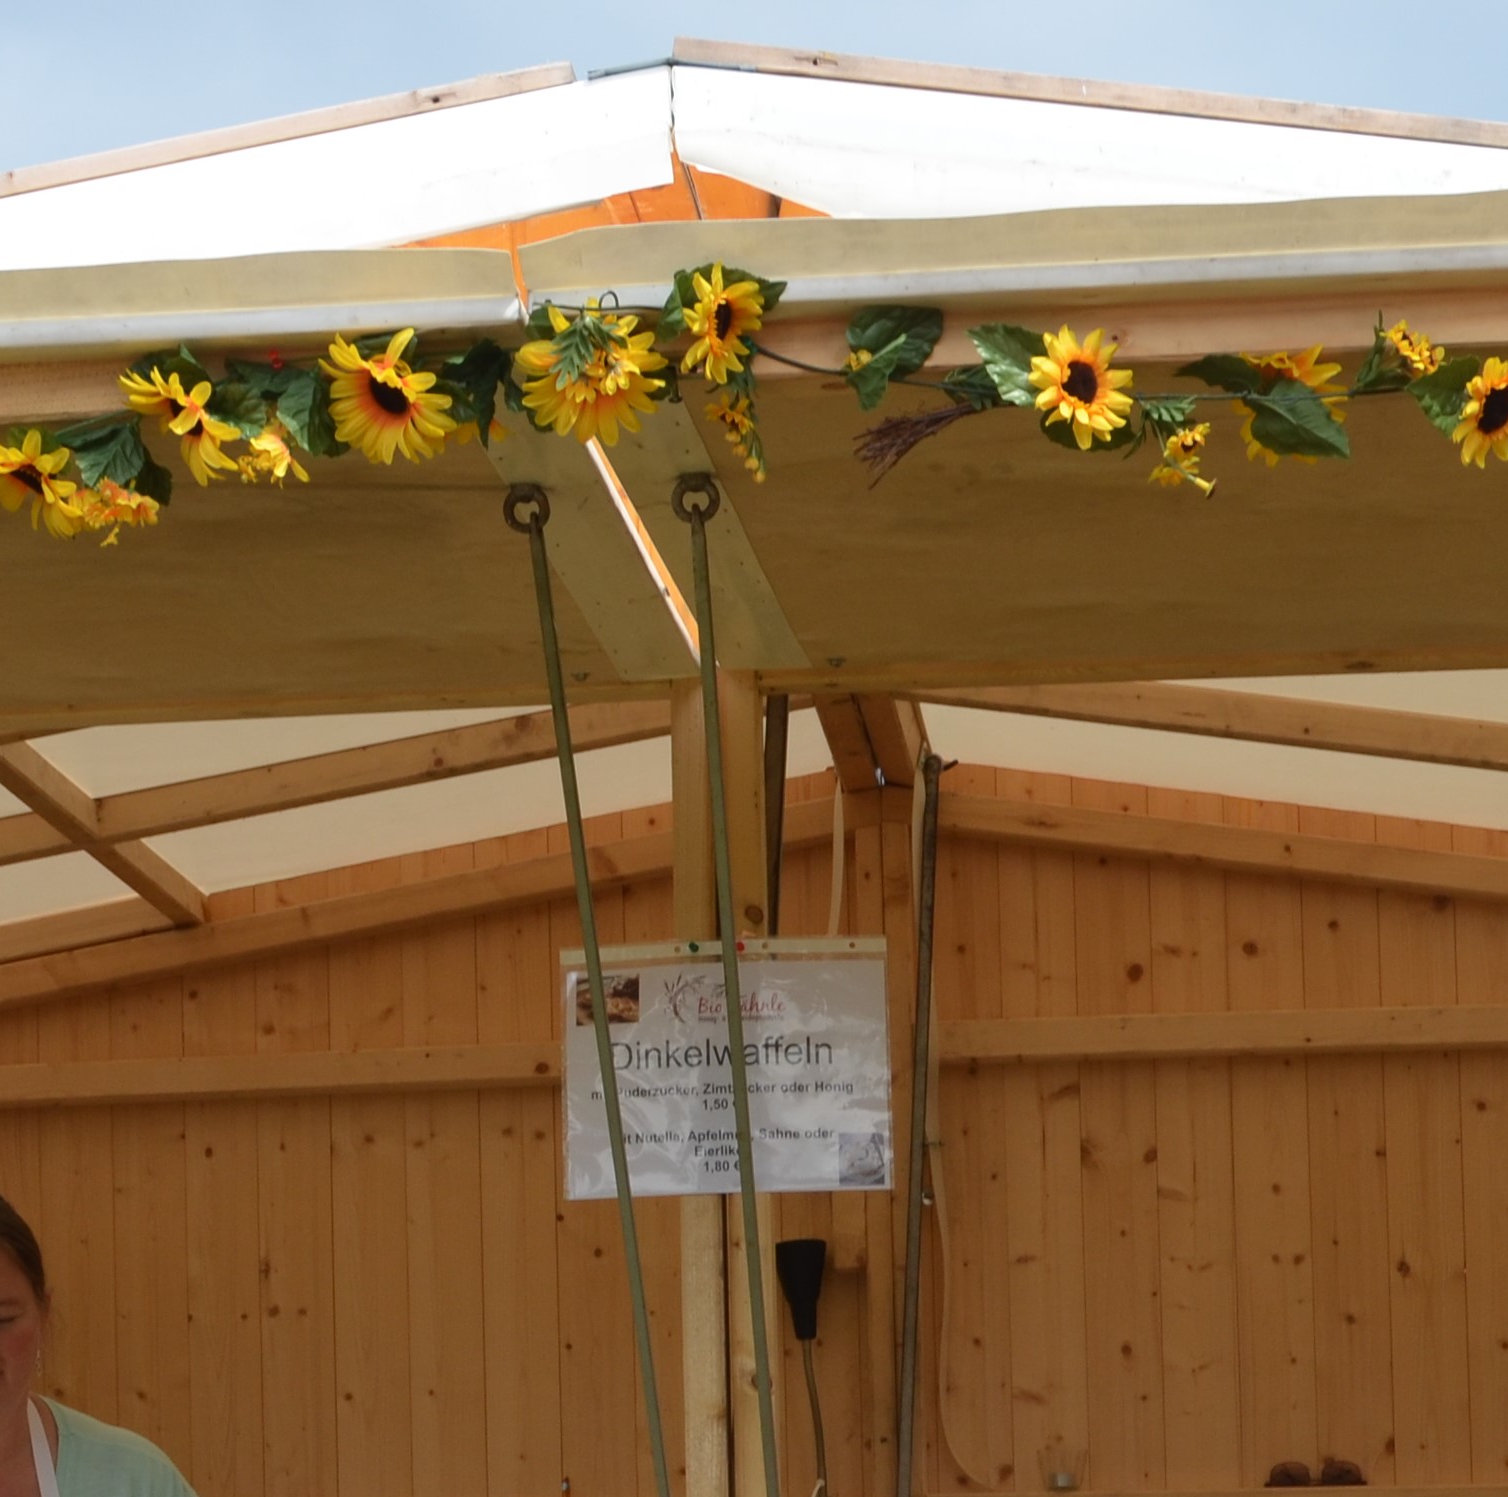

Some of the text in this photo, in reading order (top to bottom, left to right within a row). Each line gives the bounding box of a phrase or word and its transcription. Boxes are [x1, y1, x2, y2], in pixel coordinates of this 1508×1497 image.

[697, 991, 786, 1015] Bio ähnle
[611, 1036, 833, 1071] Dinkelwaffeln
[702, 1081, 776, 1094] Zimtcker
[780, 1081, 810, 1093] oder
[814, 1080, 854, 1094] Honig
[702, 1098, 729, 1112] 1,50
[635, 1130, 684, 1145] Nutella,
[758, 1128, 800, 1140] Sahne
[804, 1127, 836, 1139] oder
[703, 1160, 730, 1174] 1,80
